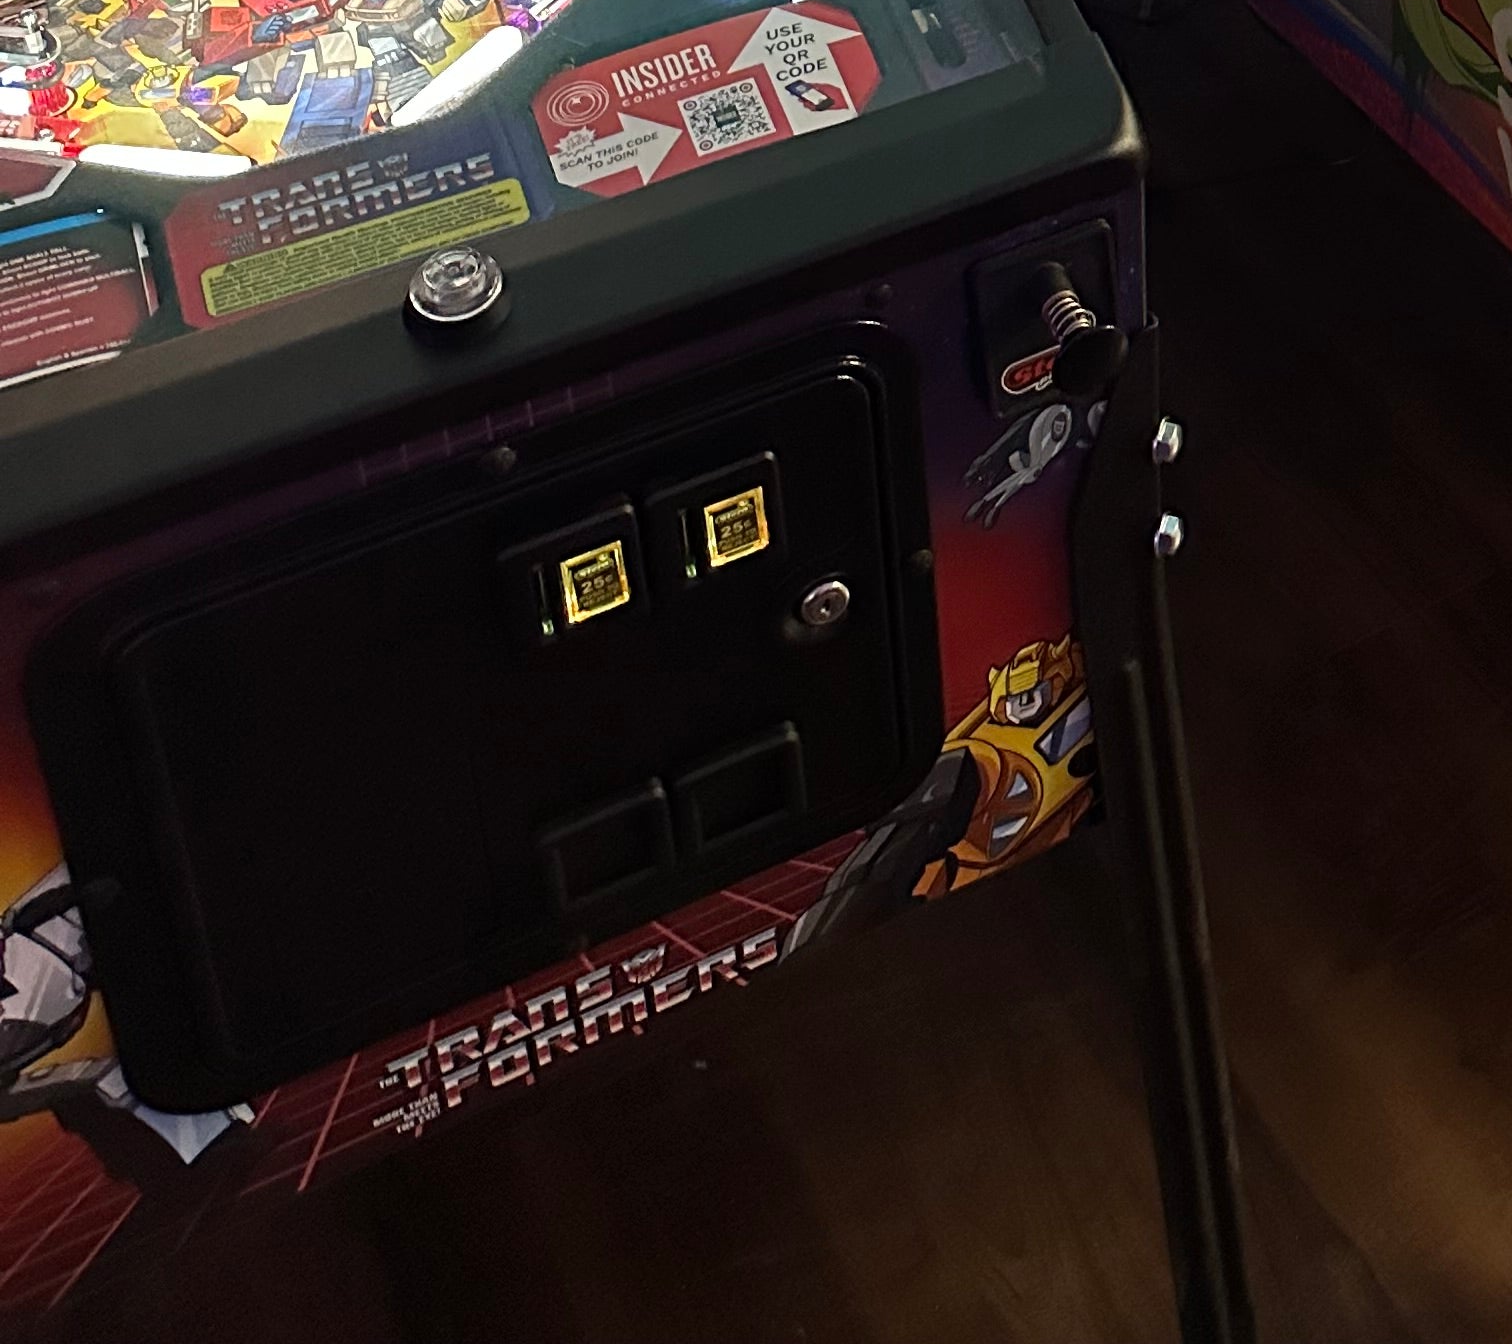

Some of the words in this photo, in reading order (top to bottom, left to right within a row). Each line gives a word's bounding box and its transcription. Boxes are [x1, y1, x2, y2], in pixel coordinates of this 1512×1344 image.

[763, 32, 817, 56] YOUR
[765, 22, 804, 42] USE
[611, 43, 718, 99] INSIDER
[775, 57, 829, 83] CODE
[783, 48, 810, 66] QR
[622, 69, 723, 109] CONNECTED
[558, 150, 593, 172] SCAN
[594, 143, 624, 163] THIS
[626, 131, 660, 150] CODE
[586, 159, 605, 173] TO
[606, 148, 640, 168] JOIN!
[217, 161, 375, 225] TRANS
[258, 152, 496, 246] FORMERS
[385, 965, 613, 1089] TRANS
[441, 926, 778, 1109] FORMERS
[379, 1073, 400, 1089] THE
[373, 1106, 405, 1128] MORE
[409, 1091, 439, 1111] THAN
[403, 1100, 440, 1121] MEETS
[396, 1120, 415, 1134] THE
